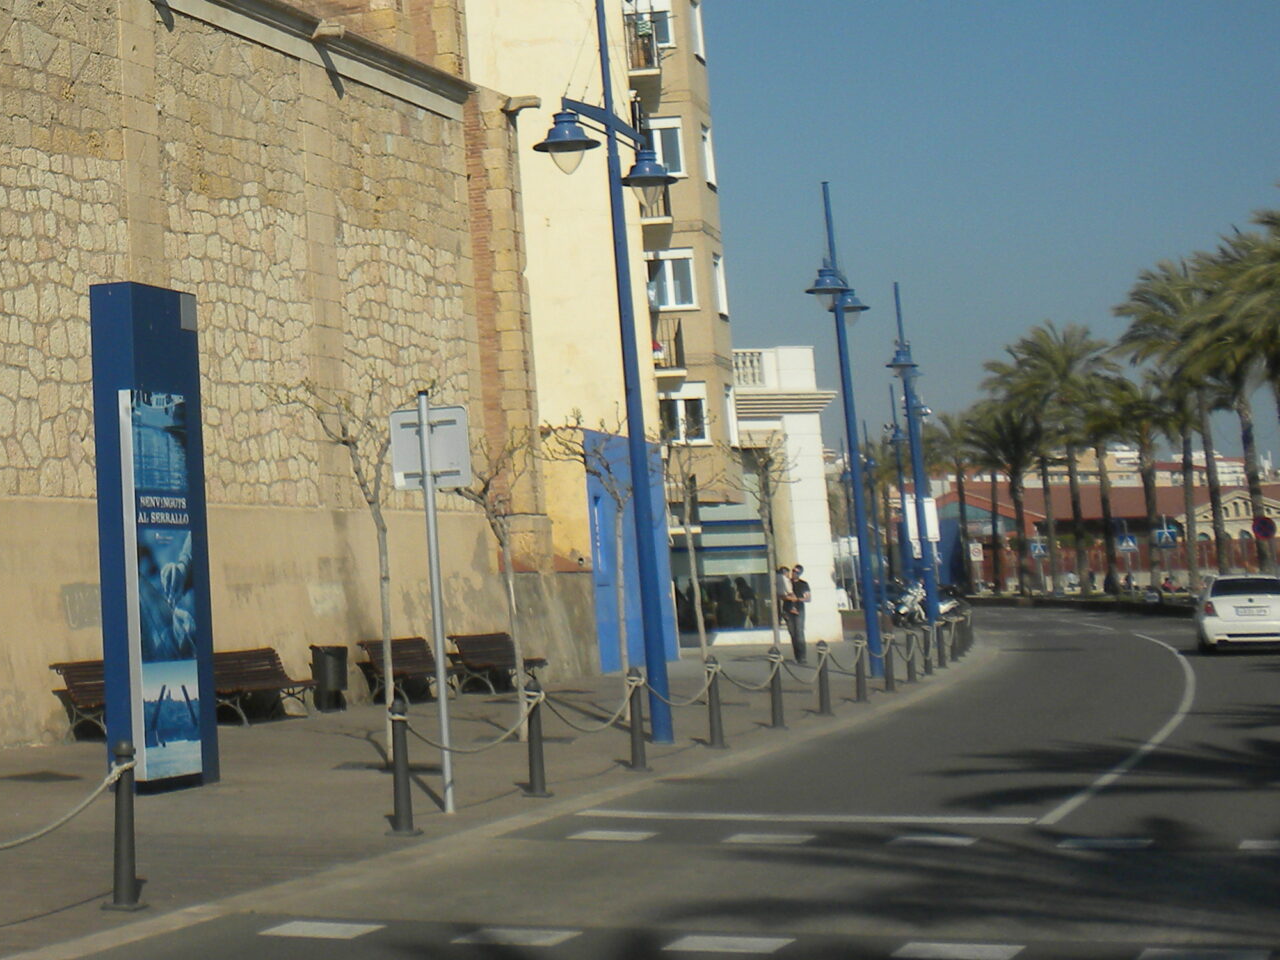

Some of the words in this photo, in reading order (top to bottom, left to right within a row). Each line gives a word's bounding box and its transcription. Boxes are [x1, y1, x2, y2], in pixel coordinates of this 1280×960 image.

[140, 496, 187, 509] BENVINGUTS
[138, 512, 149, 523] AL
[151, 512, 190, 524] SERRALLO
